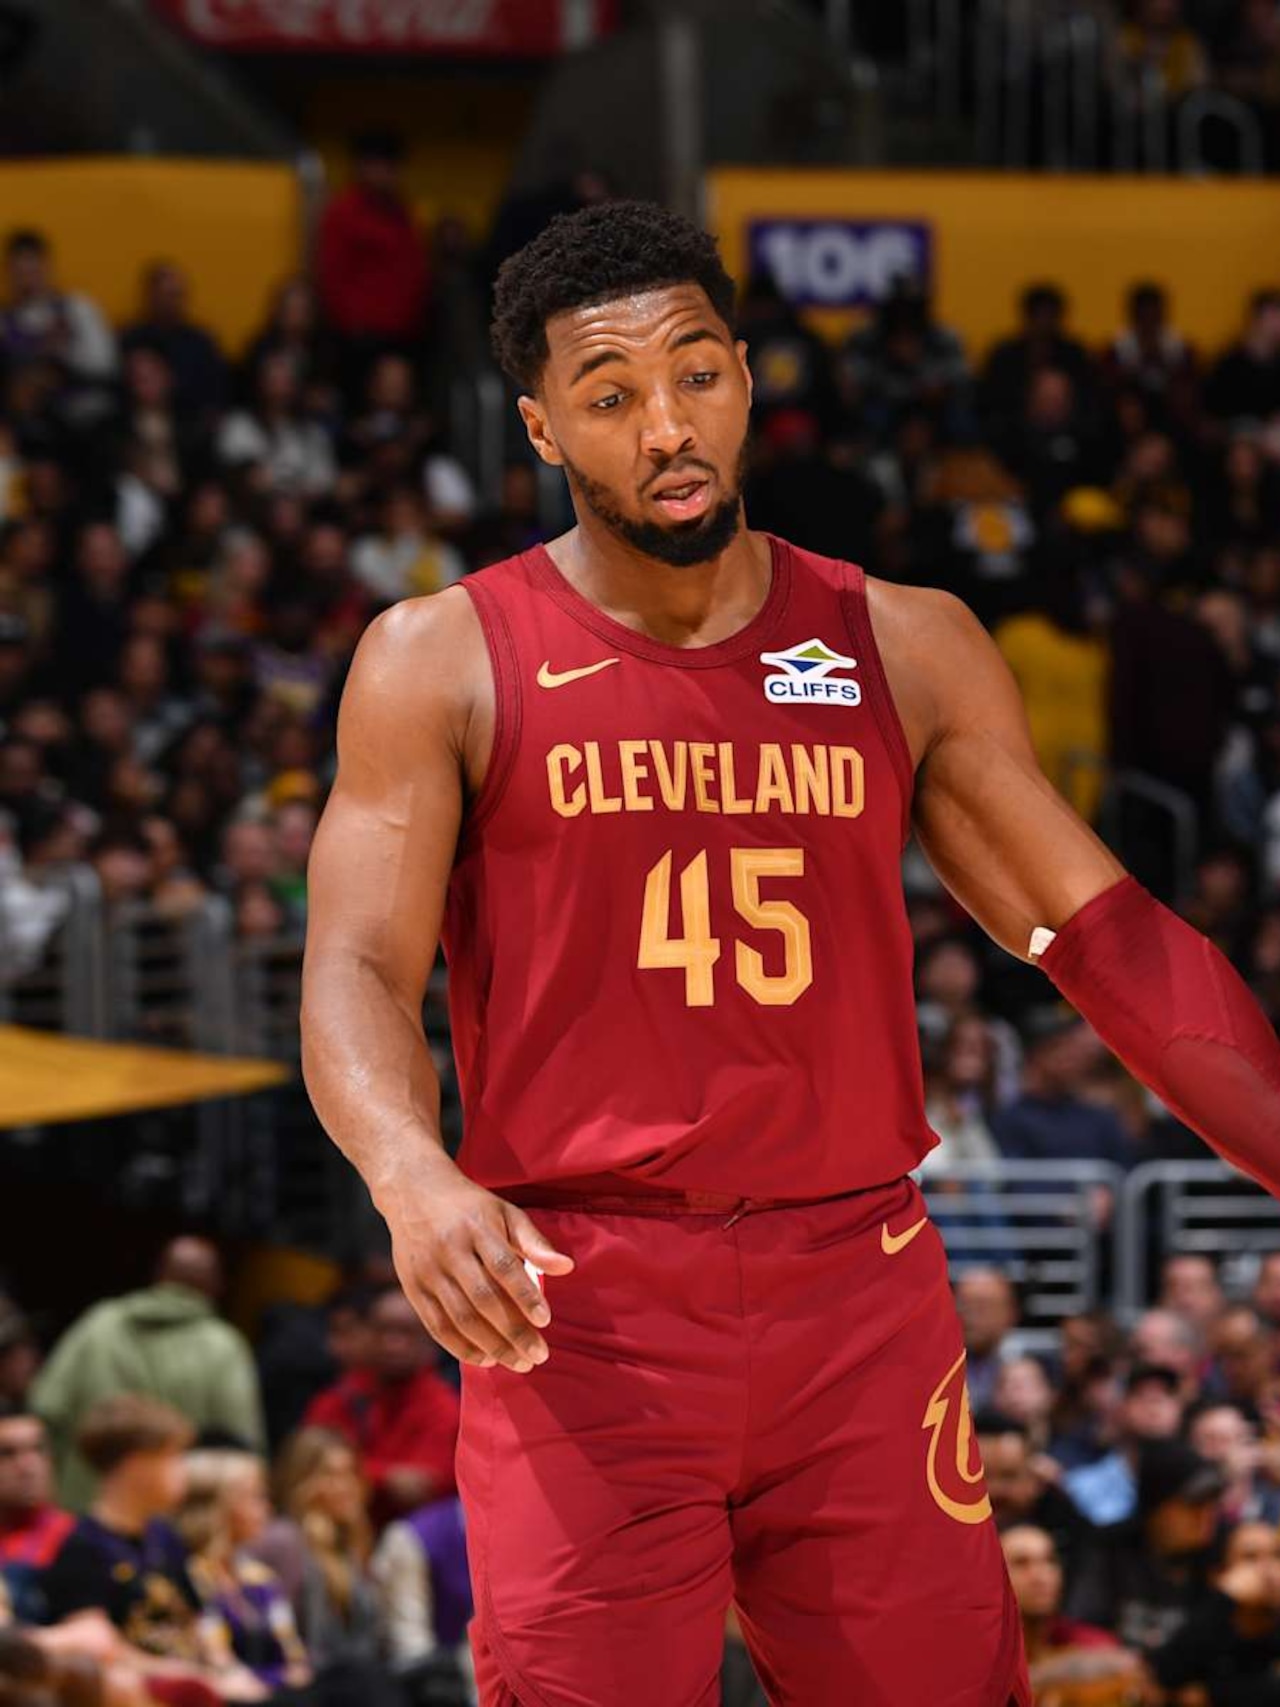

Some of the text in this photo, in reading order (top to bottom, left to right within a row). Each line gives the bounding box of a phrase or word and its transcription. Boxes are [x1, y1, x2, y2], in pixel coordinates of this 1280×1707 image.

[769, 681, 857, 700] CLIFFS
[546, 740, 865, 818] CLEVELAND
[637, 848, 813, 1006] 45
